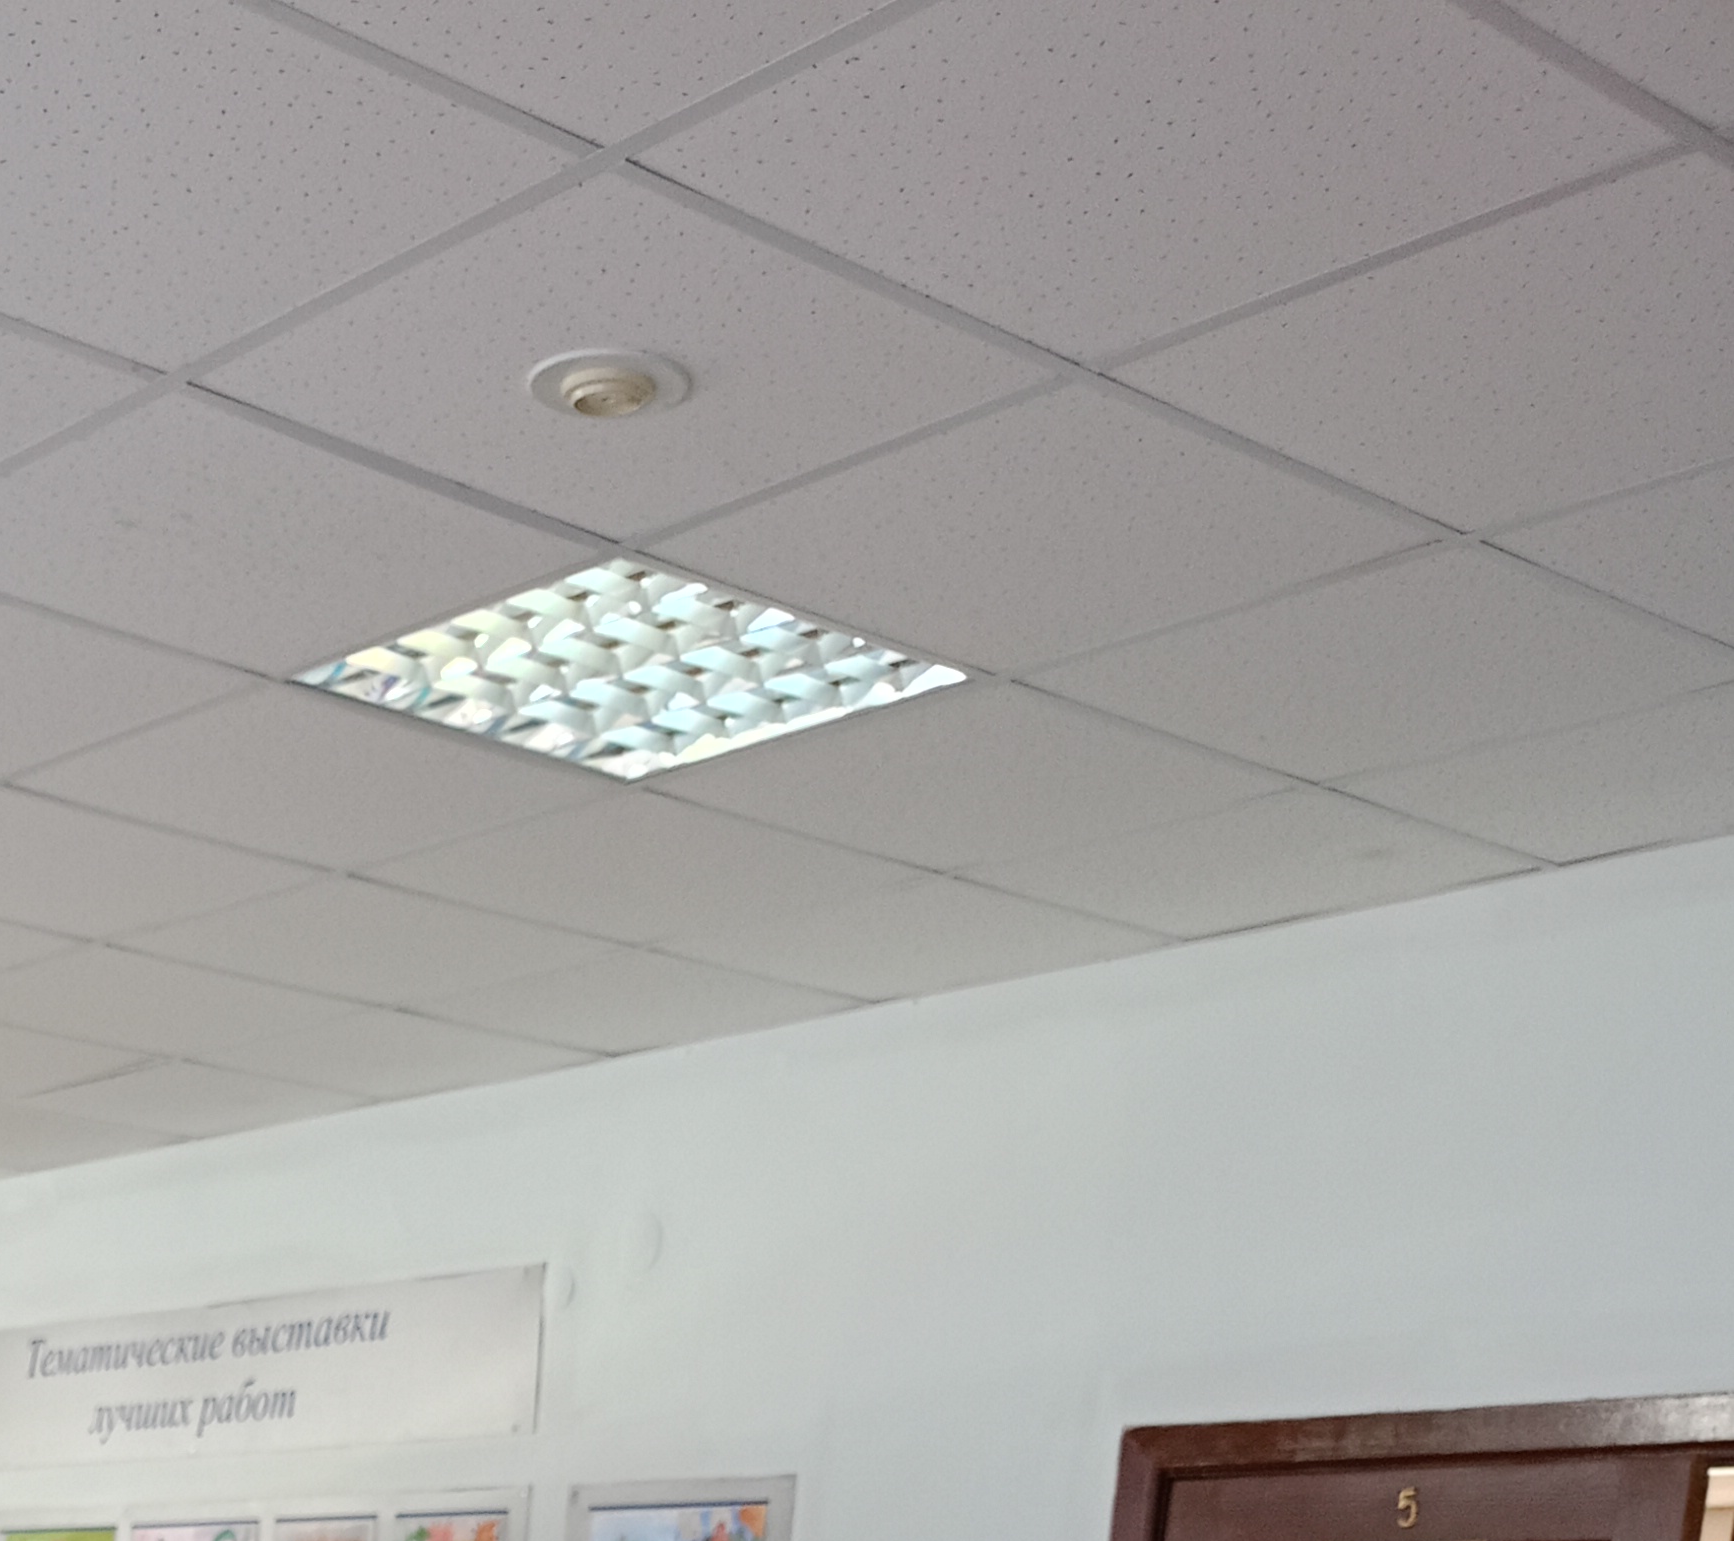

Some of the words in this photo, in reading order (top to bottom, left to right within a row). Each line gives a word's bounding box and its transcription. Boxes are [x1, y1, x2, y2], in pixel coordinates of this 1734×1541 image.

[26, 1331, 229, 1379] Тематические
[232, 1311, 391, 1358] выставки
[88, 1398, 194, 1444] лучших
[197, 1376, 297, 1438] работ
[1397, 1486, 1417, 1528] 5
